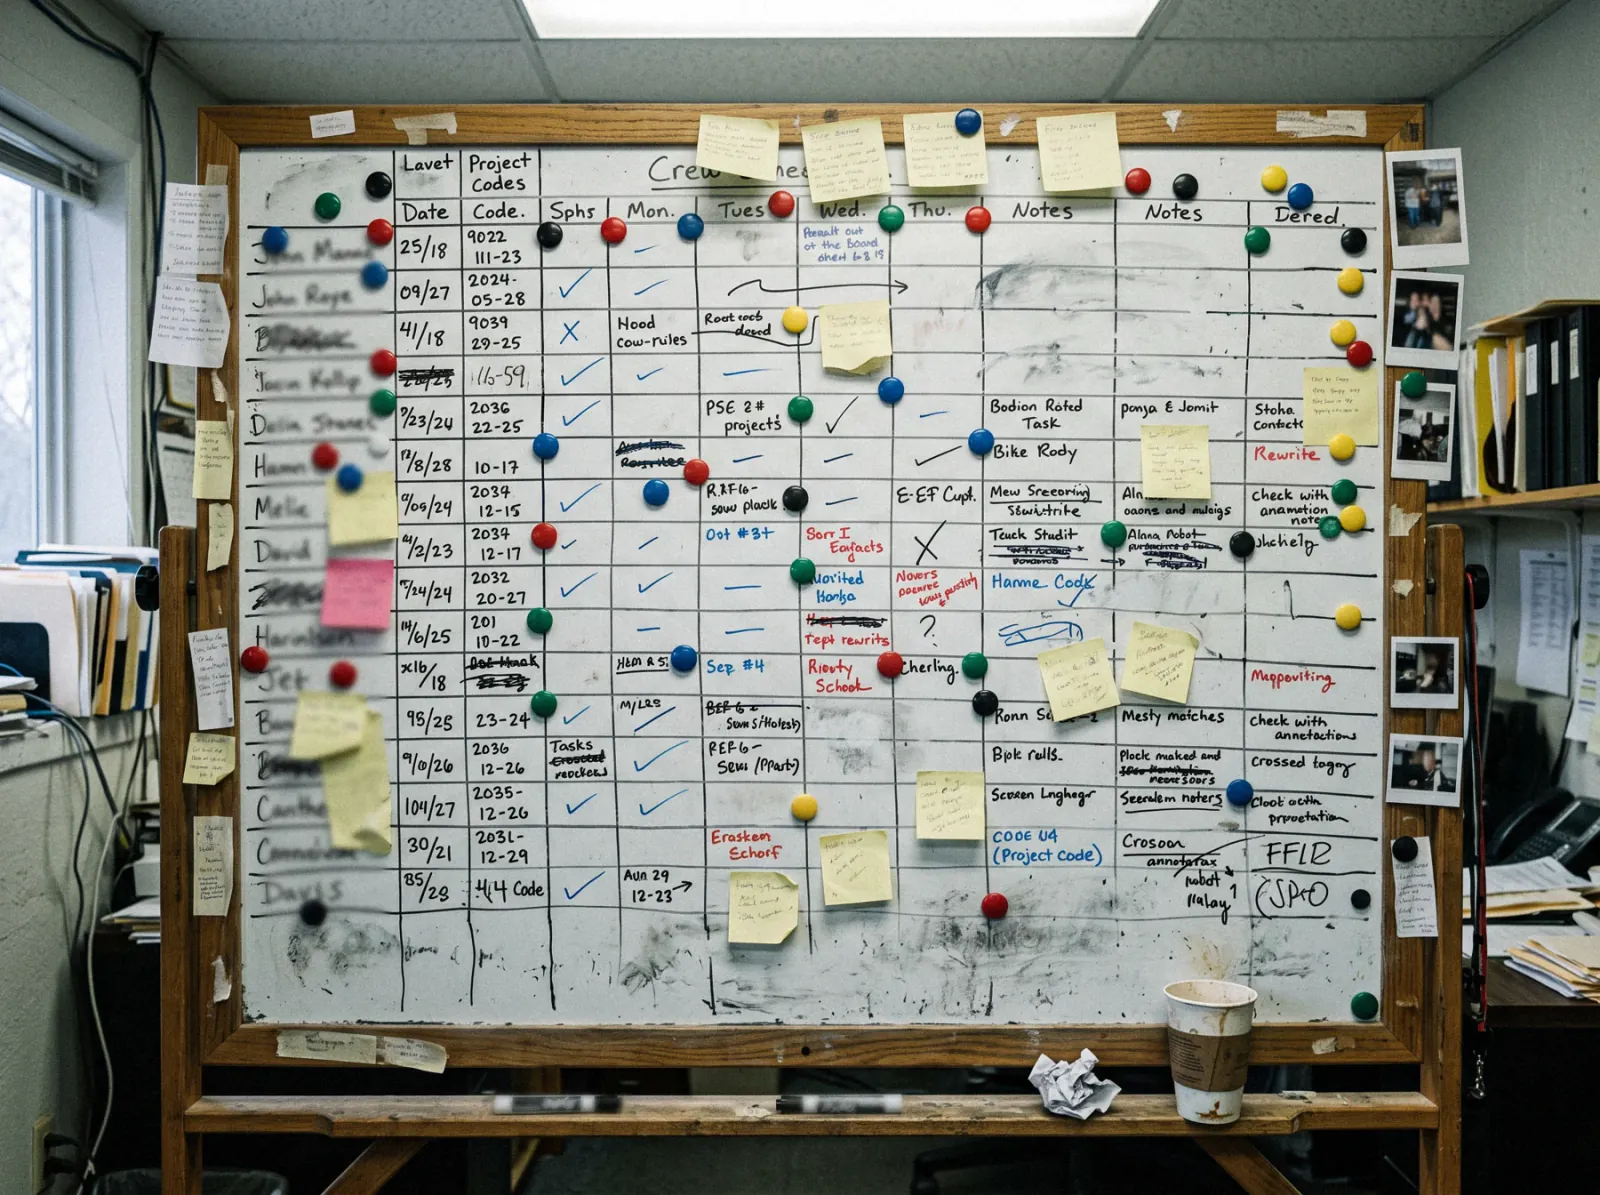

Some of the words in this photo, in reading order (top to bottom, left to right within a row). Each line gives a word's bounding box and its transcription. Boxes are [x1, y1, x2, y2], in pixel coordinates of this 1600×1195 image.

[469, 154, 531, 178] Project
[472, 177, 526, 192] Codes
[402, 203, 449, 220] Date
[627, 202, 675, 218] Mon.
[718, 202, 764, 218] Tues
[819, 200, 866, 218] Wed.
[908, 202, 951, 217] Thu.
[1012, 202, 1073, 219] Notes
[1145, 203, 1203, 221] Notes
[467, 230, 507, 243] 9022
[400, 235, 448, 263] 25/18
[400, 279, 450, 305] 09/27
[471, 292, 526, 306] 05-28
[469, 316, 508, 330] 9039
[470, 402, 510, 415] 2036
[472, 419, 524, 434] 22-25
[1022, 417, 1061, 429] Task
[993, 444, 1028, 459] Bike
[1254, 446, 1321, 461] Rewrite
[475, 461, 519, 475] 10-17
[1300, 489, 1329, 501] with
[1165, 503, 1185, 515] and
[481, 547, 521, 561] 12-17
[471, 572, 510, 584] 2032
[476, 591, 526, 605] 20-27
[476, 712, 530, 729] 23-24
[1295, 715, 1327, 727] with
[549, 739, 593, 753] Tasks
[481, 763, 525, 776] 12-26
[481, 850, 528, 864] 12-29
[513, 880, 544, 897] Code
